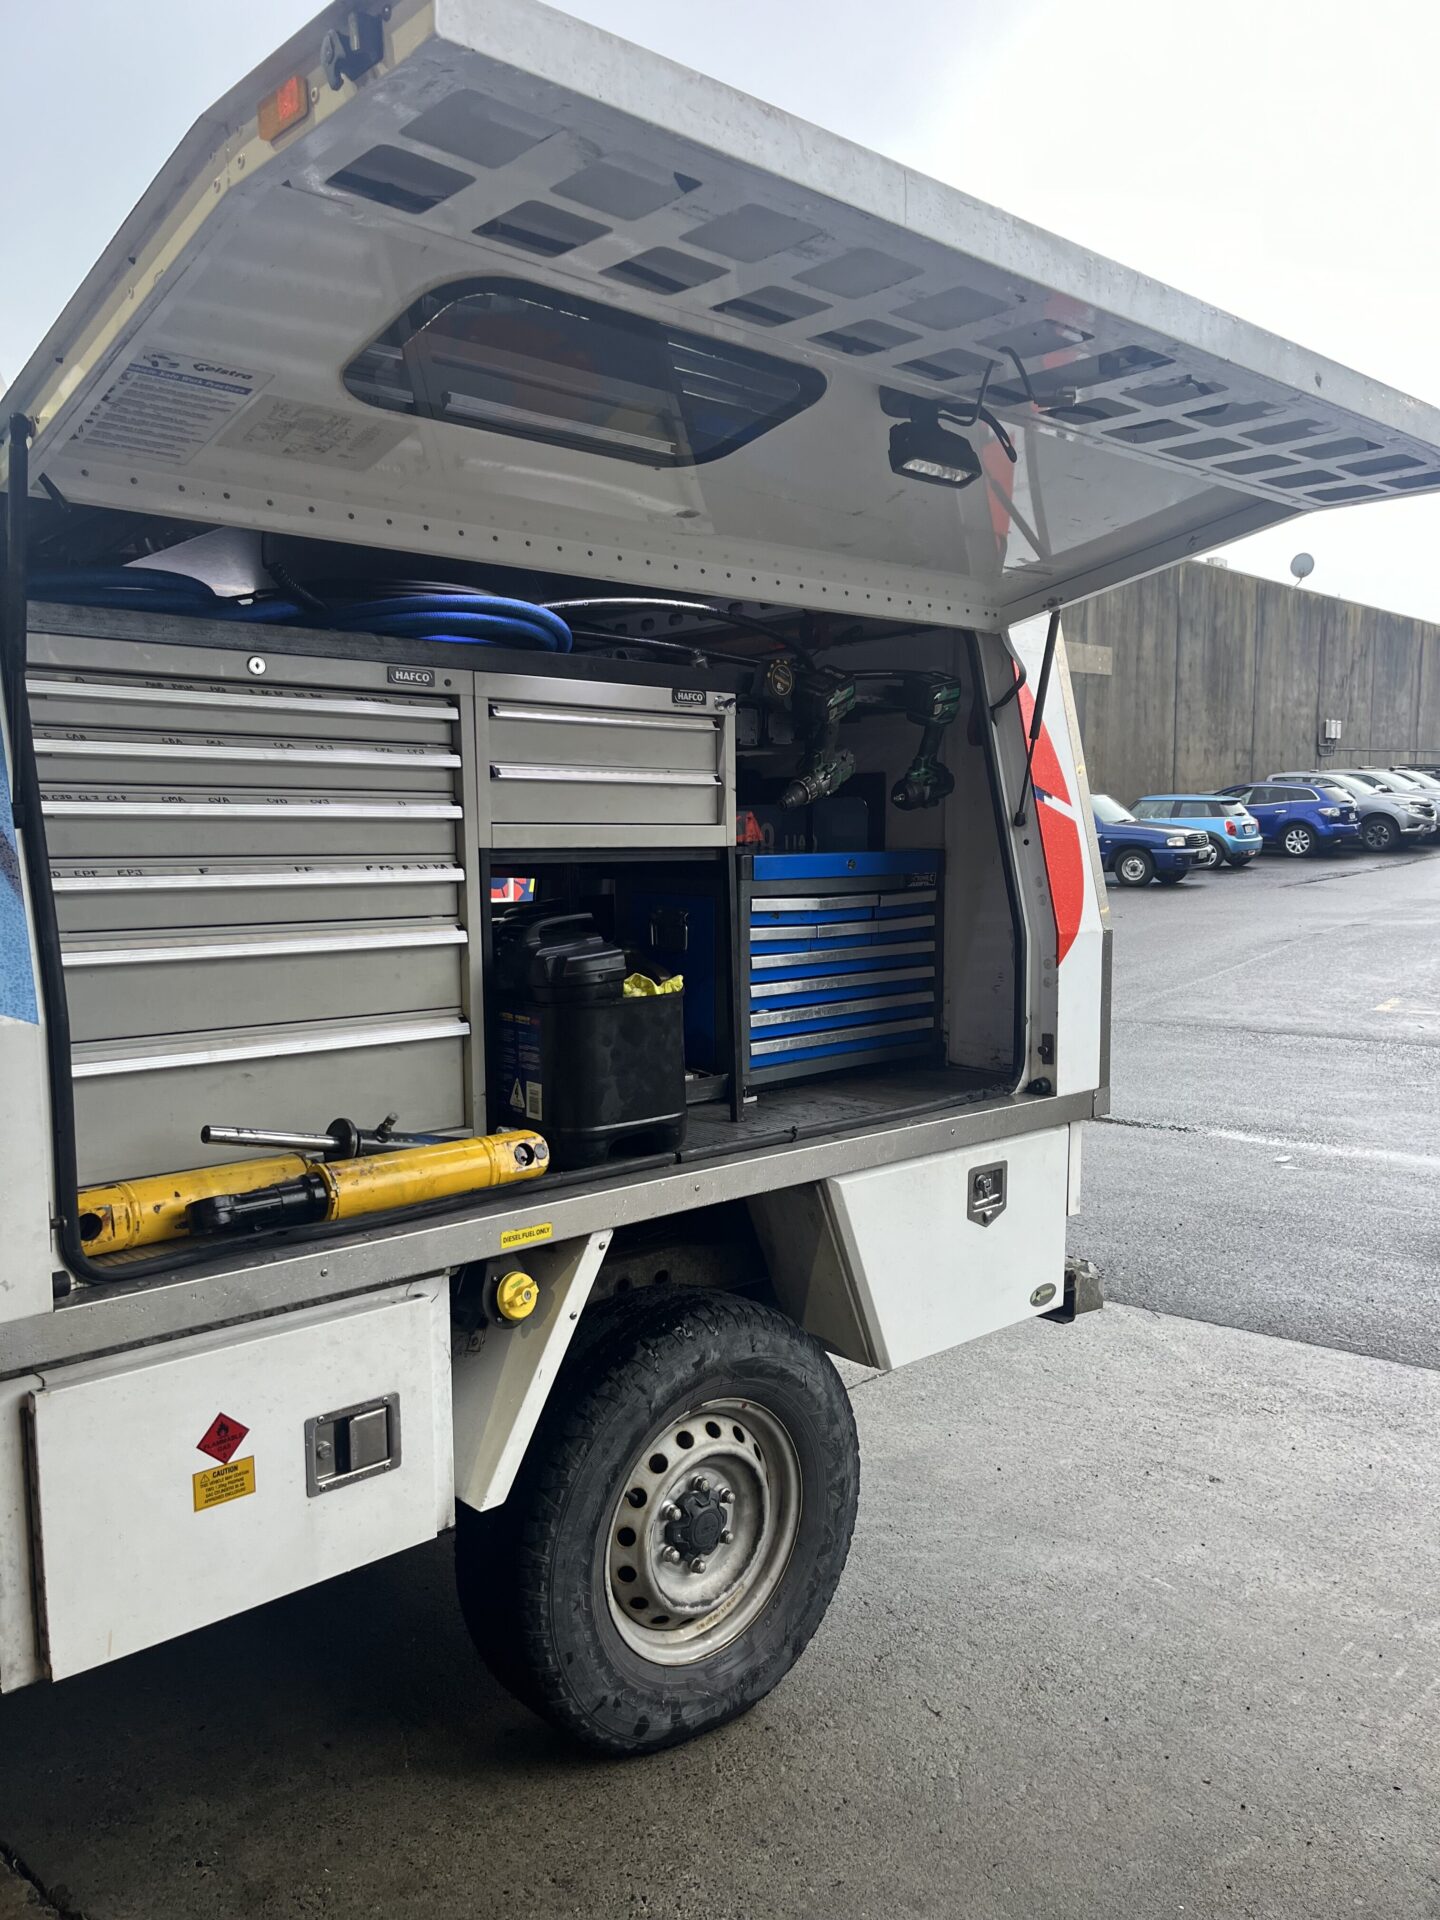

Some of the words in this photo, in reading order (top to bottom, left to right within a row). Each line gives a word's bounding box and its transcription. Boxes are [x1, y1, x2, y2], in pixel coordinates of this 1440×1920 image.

[395, 670, 430, 683] HAFCO
[677, 692, 703, 703] HAFCO
[503, 1233, 522, 1244] DIESEL
[522, 1230, 535, 1240] FUEL
[536, 1227, 550, 1237] ONLY
[212, 1464, 239, 1479] CAUTION
